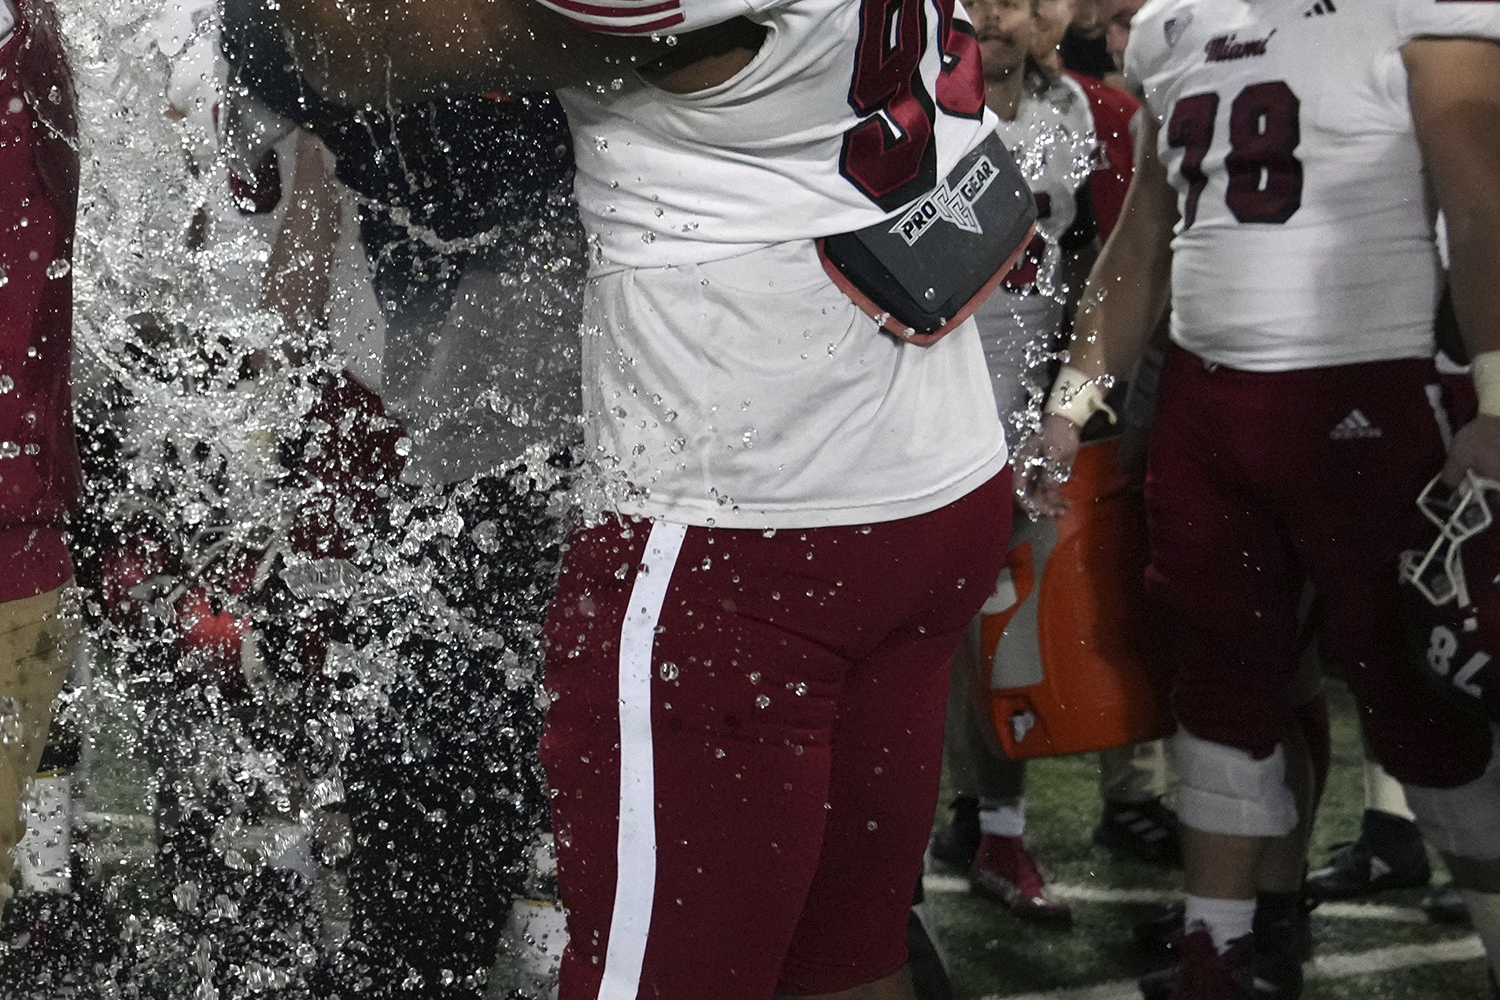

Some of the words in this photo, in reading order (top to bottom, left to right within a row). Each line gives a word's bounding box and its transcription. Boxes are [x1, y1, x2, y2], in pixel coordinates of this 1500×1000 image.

[1204, 27, 1277, 63] Miami
[1167, 79, 1304, 231] 78
[900, 200, 938, 241] PRO
[959, 161, 994, 203] GEAR
[1426, 624, 1492, 699] 78
